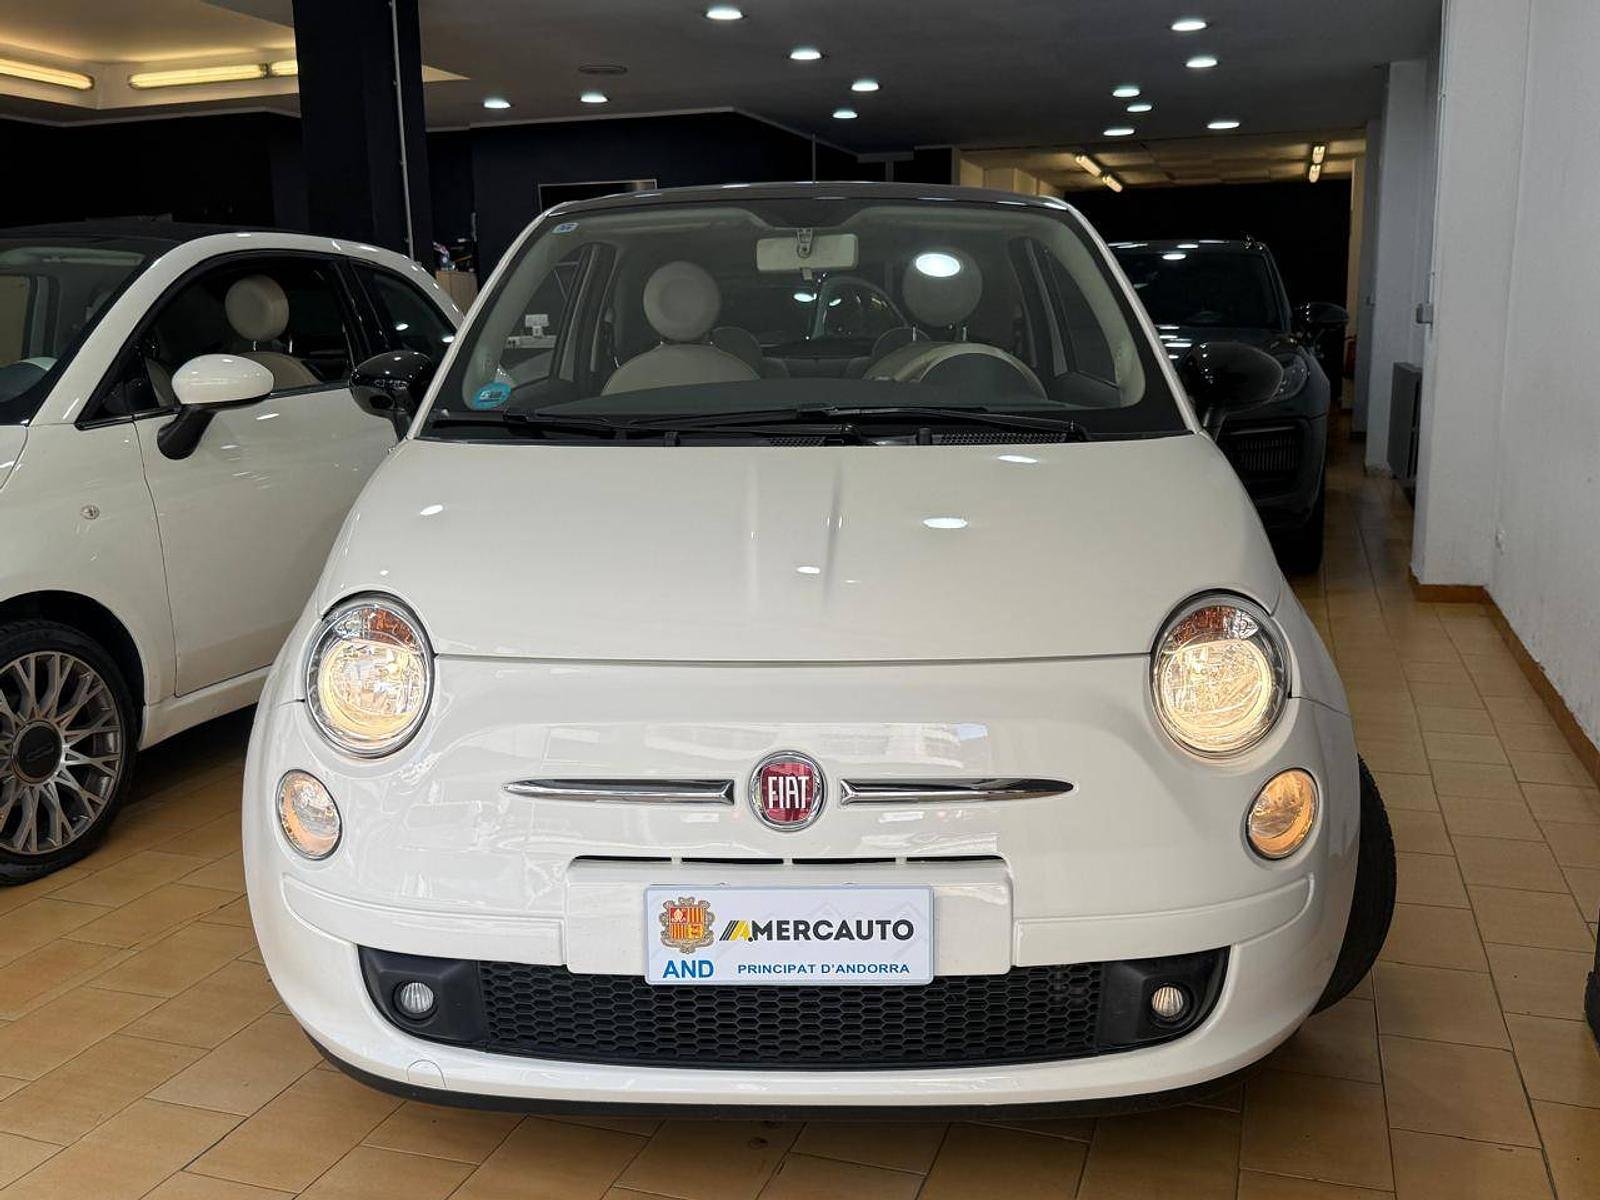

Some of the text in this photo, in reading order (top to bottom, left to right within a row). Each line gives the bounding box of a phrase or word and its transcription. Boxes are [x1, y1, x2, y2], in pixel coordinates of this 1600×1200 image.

[767, 776, 810, 809] FIAT
[662, 959, 714, 979] AND
[737, 963, 910, 974] PRINCIPAT D'ANDORRA
